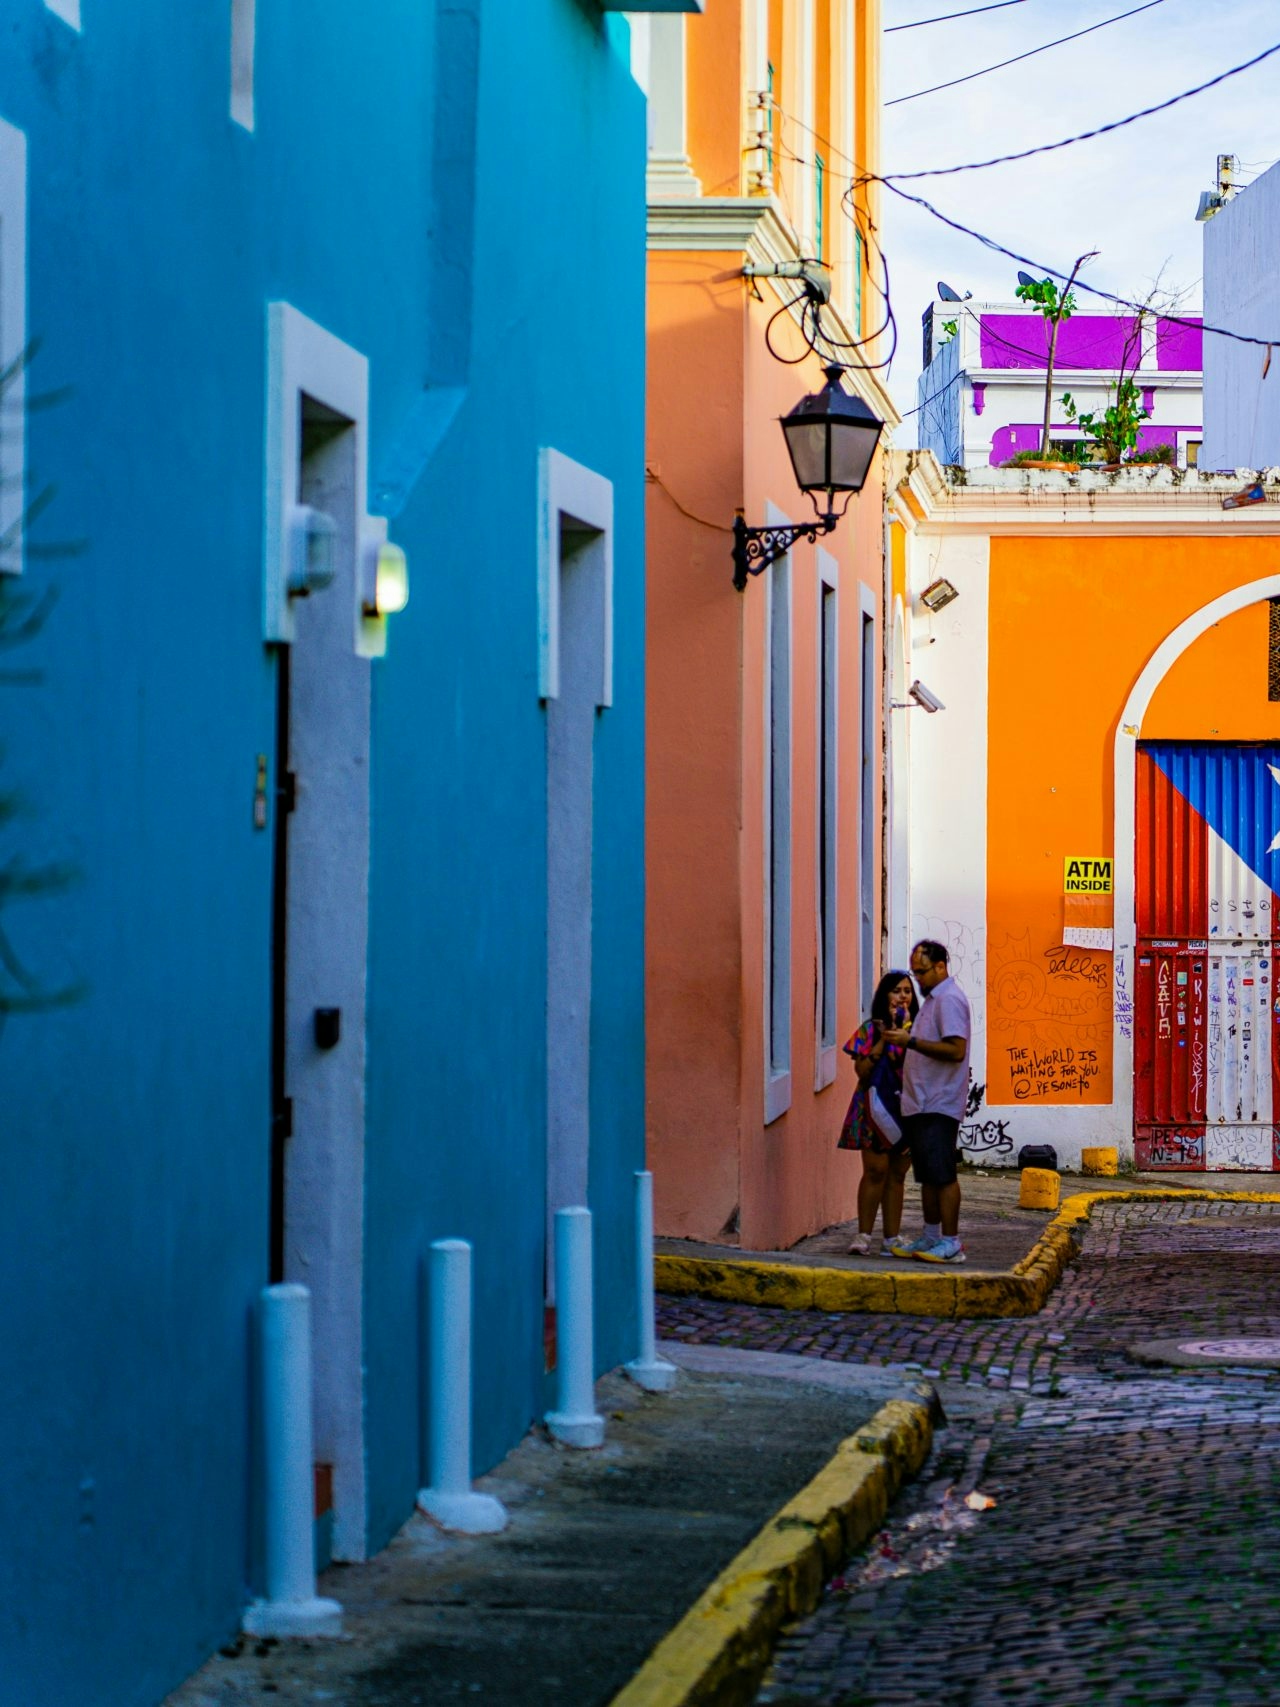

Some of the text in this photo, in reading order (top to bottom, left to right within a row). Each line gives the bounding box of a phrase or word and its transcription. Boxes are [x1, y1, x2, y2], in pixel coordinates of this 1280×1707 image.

[1067, 861, 1111, 878] ATM
[1066, 880, 1111, 891] INSIDE
[1006, 1048, 1097, 1069] THE WORLD IS
[1060, 1065, 1078, 1076] FOR
[1154, 1129, 1199, 1144] PESO
